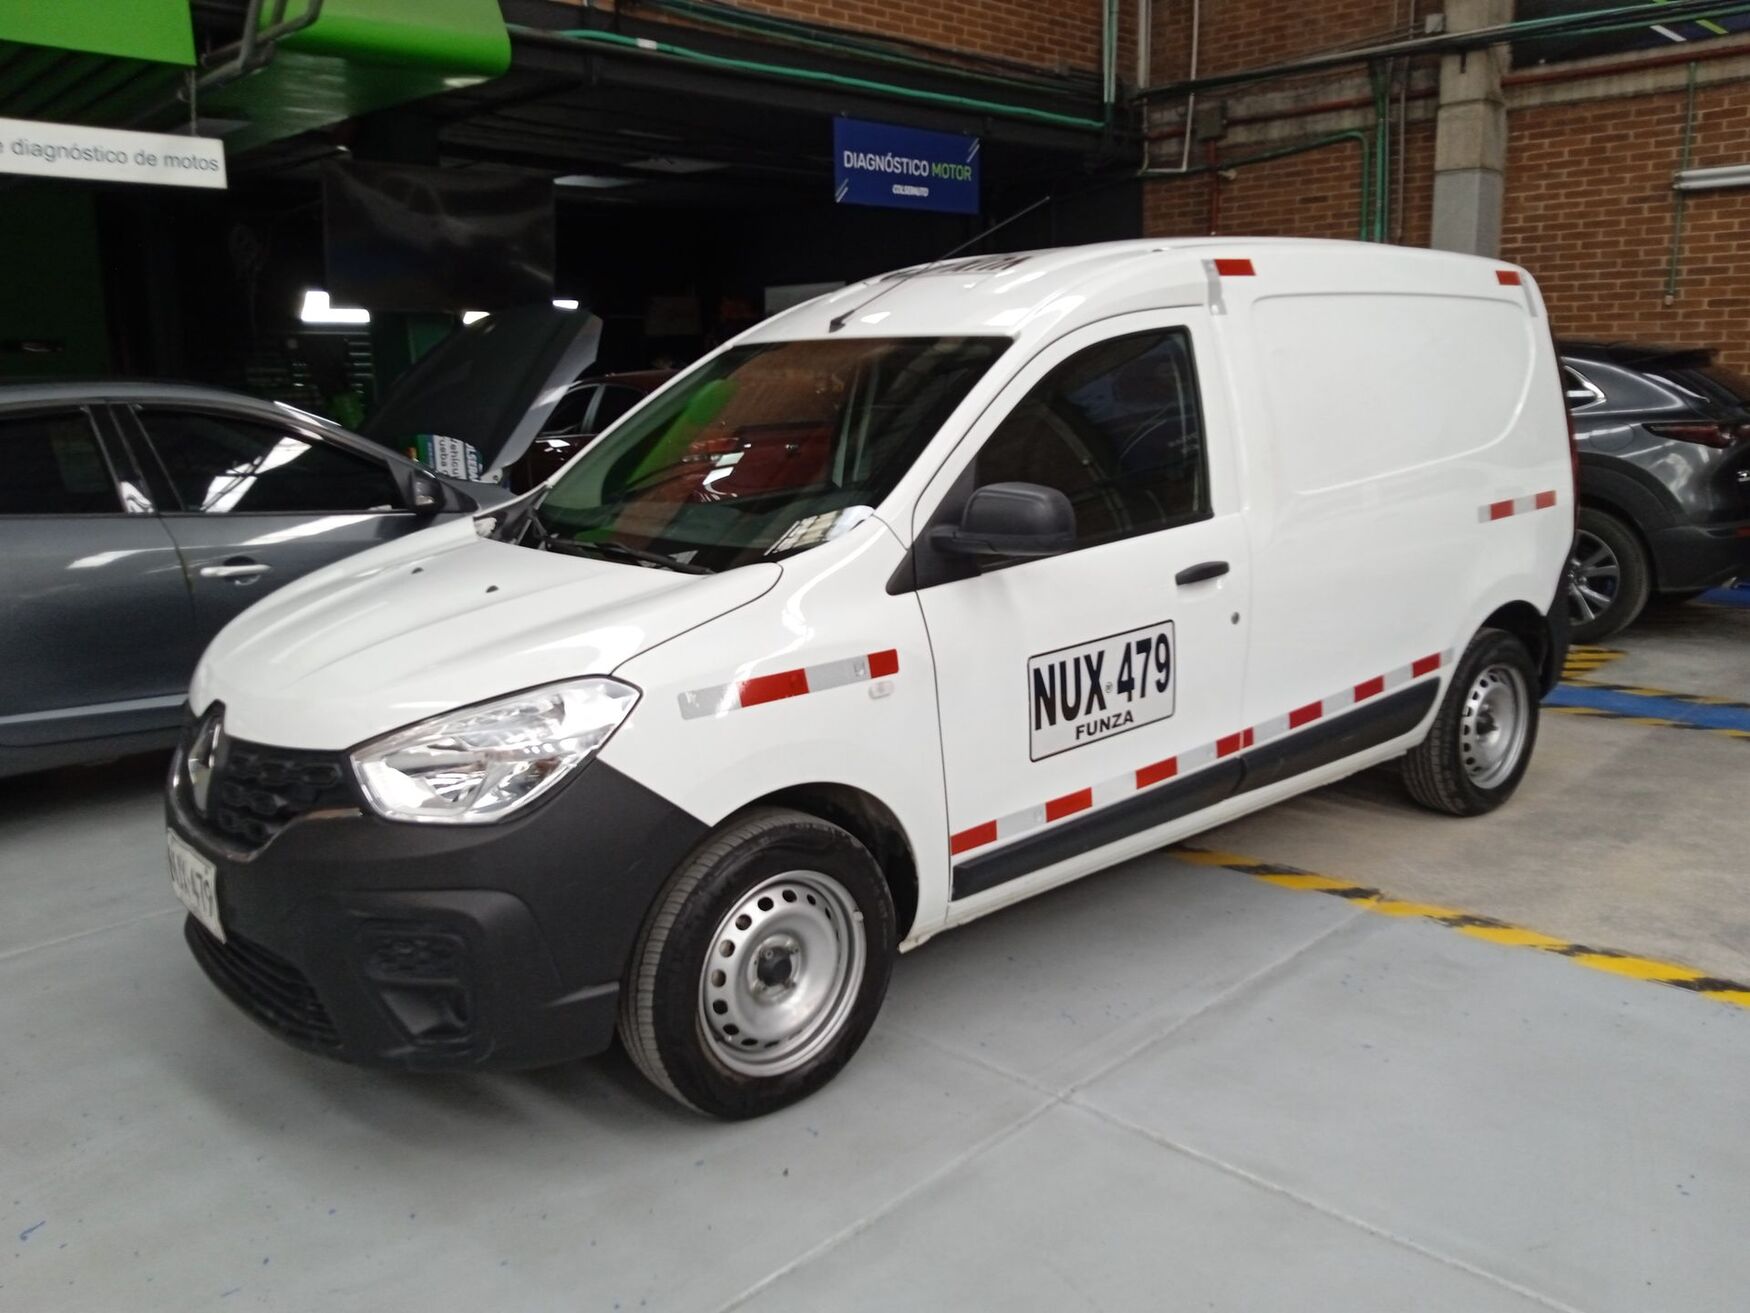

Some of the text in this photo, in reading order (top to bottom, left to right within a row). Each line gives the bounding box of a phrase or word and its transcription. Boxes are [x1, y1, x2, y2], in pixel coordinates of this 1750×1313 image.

[11, 138, 128, 164] diagnóstico
[134, 149, 157, 167] de
[164, 154, 219, 171] motos
[843, 150, 972, 181] DIAGNÓSTICO MOTOR
[1033, 633, 1171, 731] NUX 479
[1075, 709, 1134, 740] FUNZA
